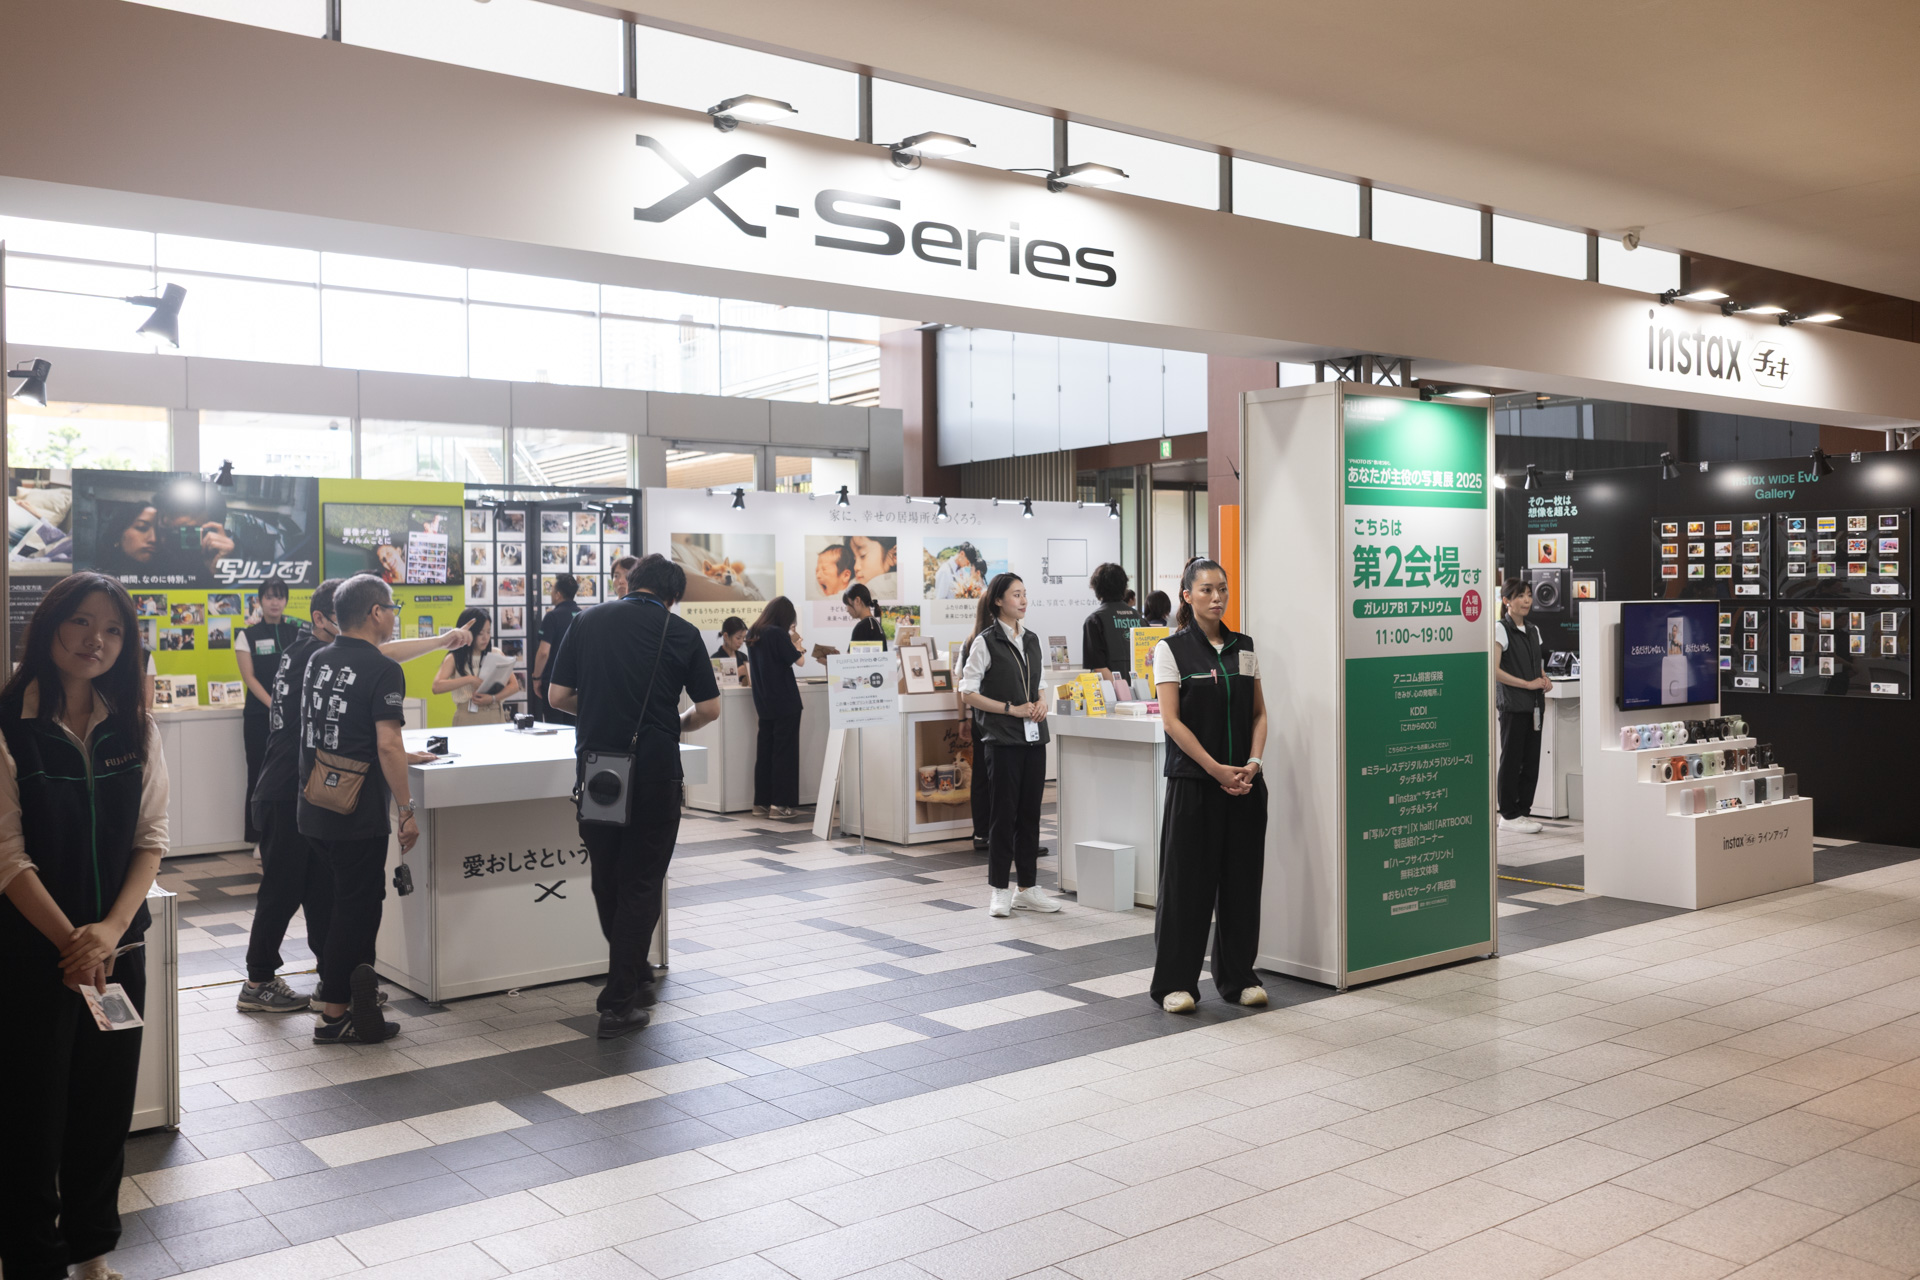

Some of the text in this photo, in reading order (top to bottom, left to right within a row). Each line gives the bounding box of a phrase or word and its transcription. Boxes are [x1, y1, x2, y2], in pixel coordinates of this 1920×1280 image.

[634, 134, 1117, 288] X-Series
[1648, 308, 1742, 382] instax
[1348, 466, 1482, 489] あなたが主役の写真展 2025
[1768, 474, 1795, 484] WIDE
[1798, 471, 1819, 483] Evo
[1528, 495, 1572, 506] その一枚は
[1755, 488, 1796, 500] Gallery
[1528, 506, 1578, 518] 想像を超える
[1354, 518, 1402, 536] こちらは
[214, 558, 312, 584] 写ルンです
[1465, 595, 1479, 605] 入場
[1363, 600, 1452, 615] ガレリアB1 アトリウム
[1465, 606, 1479, 616] 無料
[1112, 615, 1142, 629] instax
[1393, 671, 1443, 683] アニコム損害保険
[1410, 706, 1427, 716] KDDI
[1758, 827, 1789, 843] ラインアップ
[1723, 836, 1745, 850] instax
